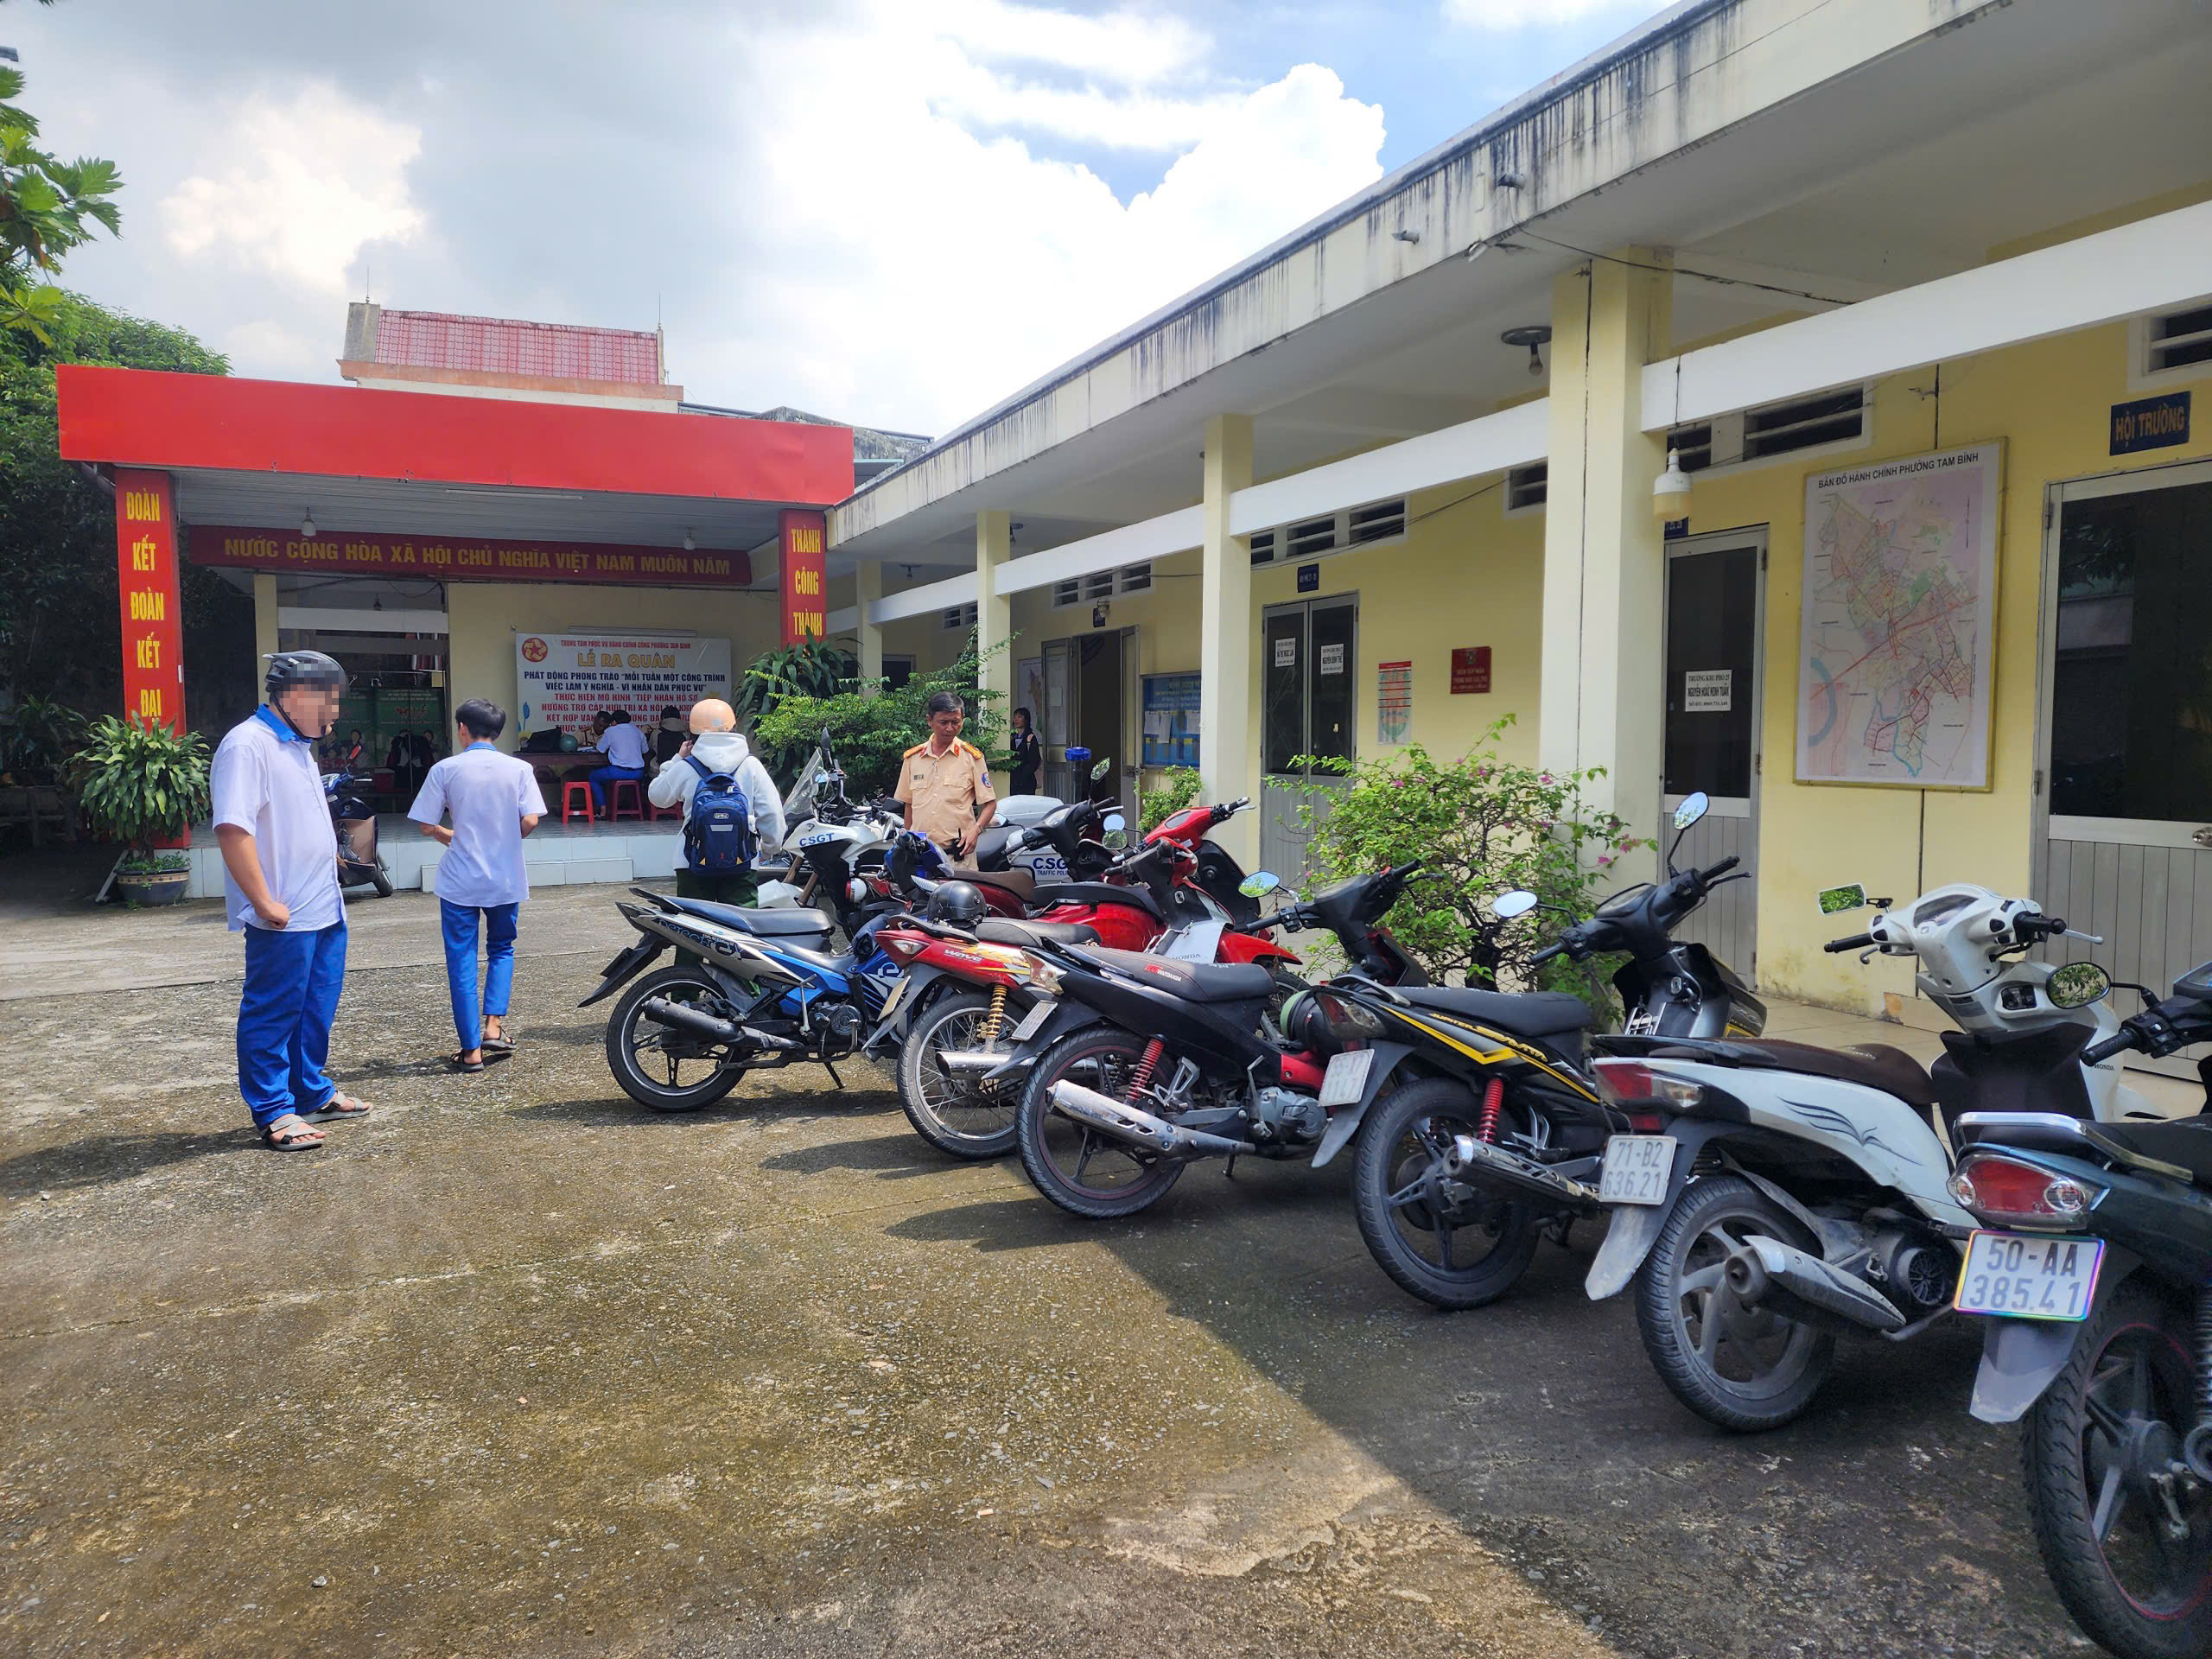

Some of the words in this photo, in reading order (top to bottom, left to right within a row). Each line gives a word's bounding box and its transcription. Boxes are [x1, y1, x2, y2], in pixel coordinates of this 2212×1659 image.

[1818, 478, 1834, 488] BẢN
[1836, 474, 1847, 486] ĐỒ
[1849, 470, 1872, 482] HÀNH
[1872, 466, 1897, 479] CHÍNH
[1899, 460, 1936, 474] PHƯỜNG
[1936, 456, 1955, 467] TAM
[1957, 451, 1980, 465] BÌNH
[125, 487, 161, 522] ĐOÀN
[132, 534, 156, 571] KẾT
[224, 535, 279, 557] NƯỚC
[285, 538, 339, 563] CỘNG
[345, 539, 383, 562] HÒA
[390, 543, 416, 563] XÃ
[423, 544, 452, 569] HỘI
[457, 545, 492, 566] CHỦ
[498, 548, 551, 569] NGHĨA
[555, 550, 590, 573] VIỆT
[595, 554, 635, 572] NAM
[640, 554, 689, 574] MUÔN
[693, 556, 731, 575] NĂM
[791, 524, 821, 554] THÀNH
[795, 566, 819, 595] CÔNG
[130, 587, 164, 621] ĐOÀN
[137, 632, 161, 669] KẾT
[577, 649, 596, 667] LỄ
[601, 653, 623, 668] RA
[627, 652, 676, 669] QUÂN
[524, 671, 545, 680] PHÁT
[546, 670, 569, 682] ĐỘNG
[570, 672, 597, 681] PHONG
[663, 672, 680, 683] MỘT
[681, 673, 702, 682] CÔNG
[703, 673, 726, 682] TRÌNH
[545, 682, 563, 692] VIỆC
[632, 683, 652, 691] NHÂN
[140, 689, 162, 723] ĐẠI
[2094, 1063, 2115, 1071] HONDA
[1986, 1237, 2079, 1278] 50-AA
[1968, 1274, 2082, 1315] 385.41
